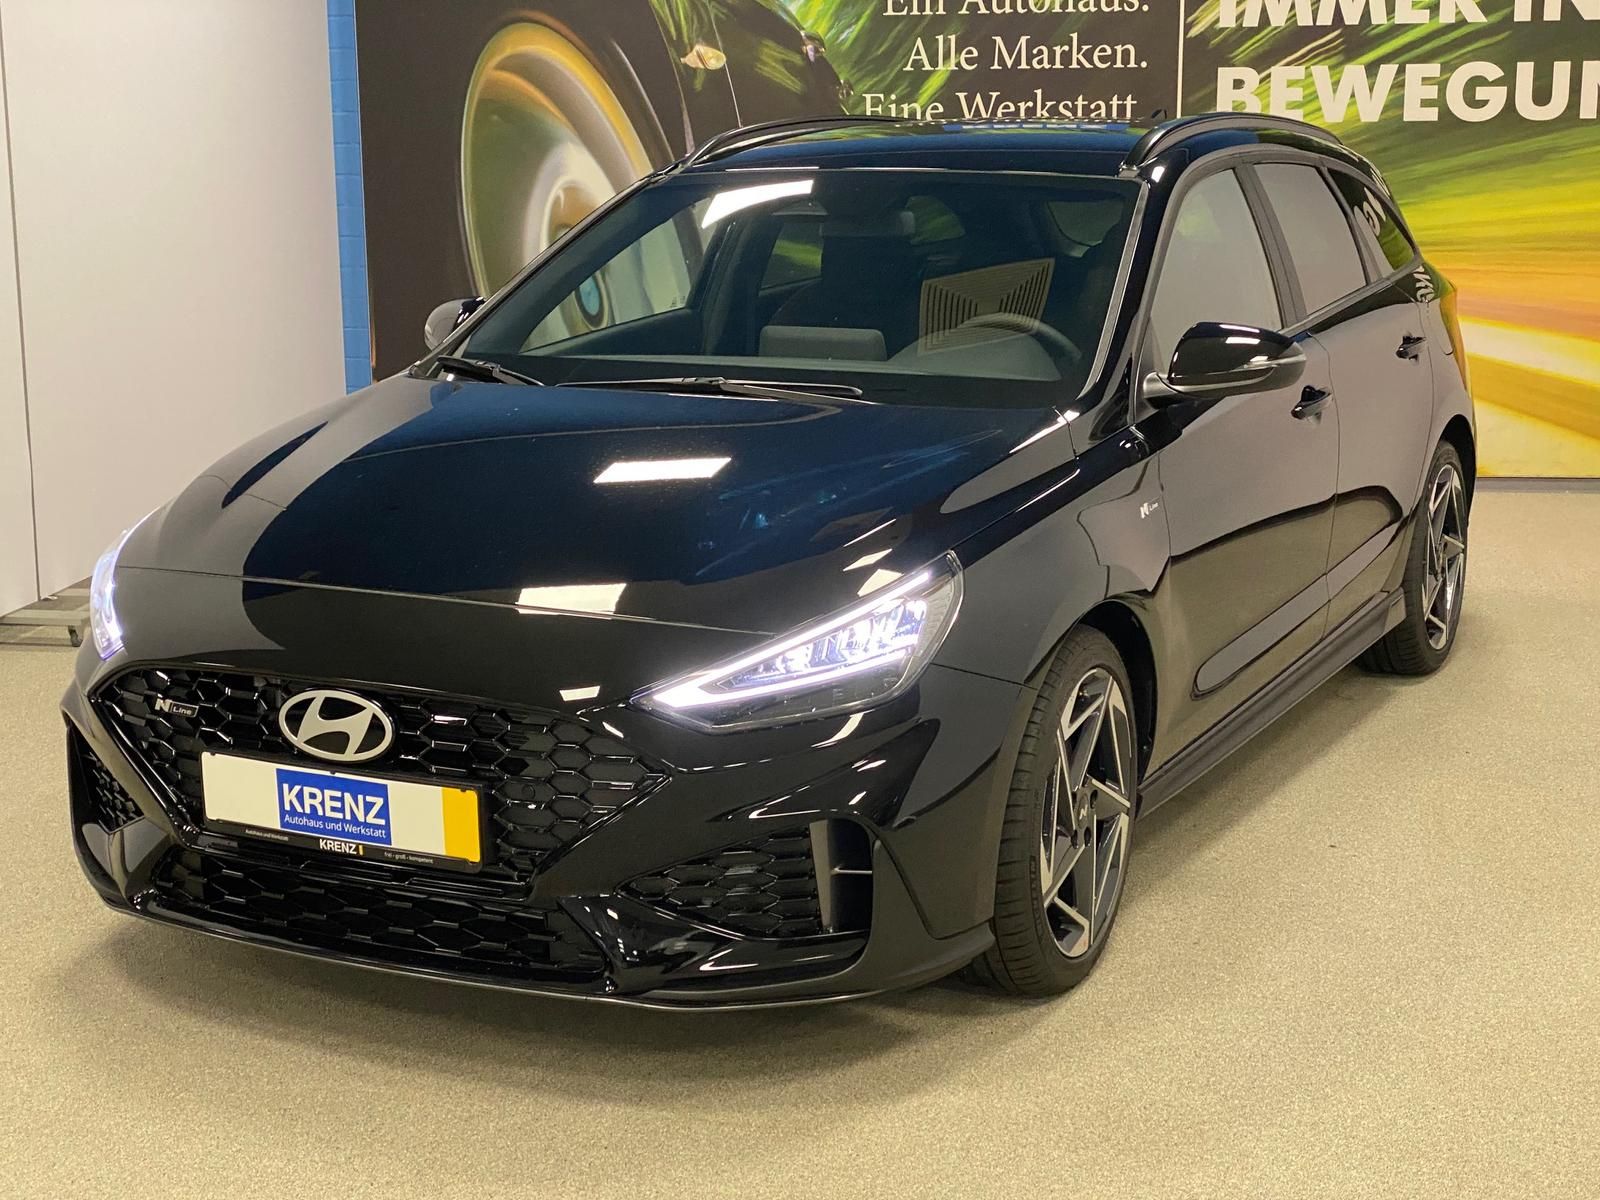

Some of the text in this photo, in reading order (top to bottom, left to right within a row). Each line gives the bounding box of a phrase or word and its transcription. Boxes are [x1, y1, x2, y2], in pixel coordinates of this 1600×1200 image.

[902, 31, 1148, 71] Alle Marken.
[862, 93, 945, 120] Eine
[282, 783, 386, 826] KRENZ
[284, 814, 387, 838] Autohaus und Werkstatt
[320, 838, 357, 855] KRENZ
